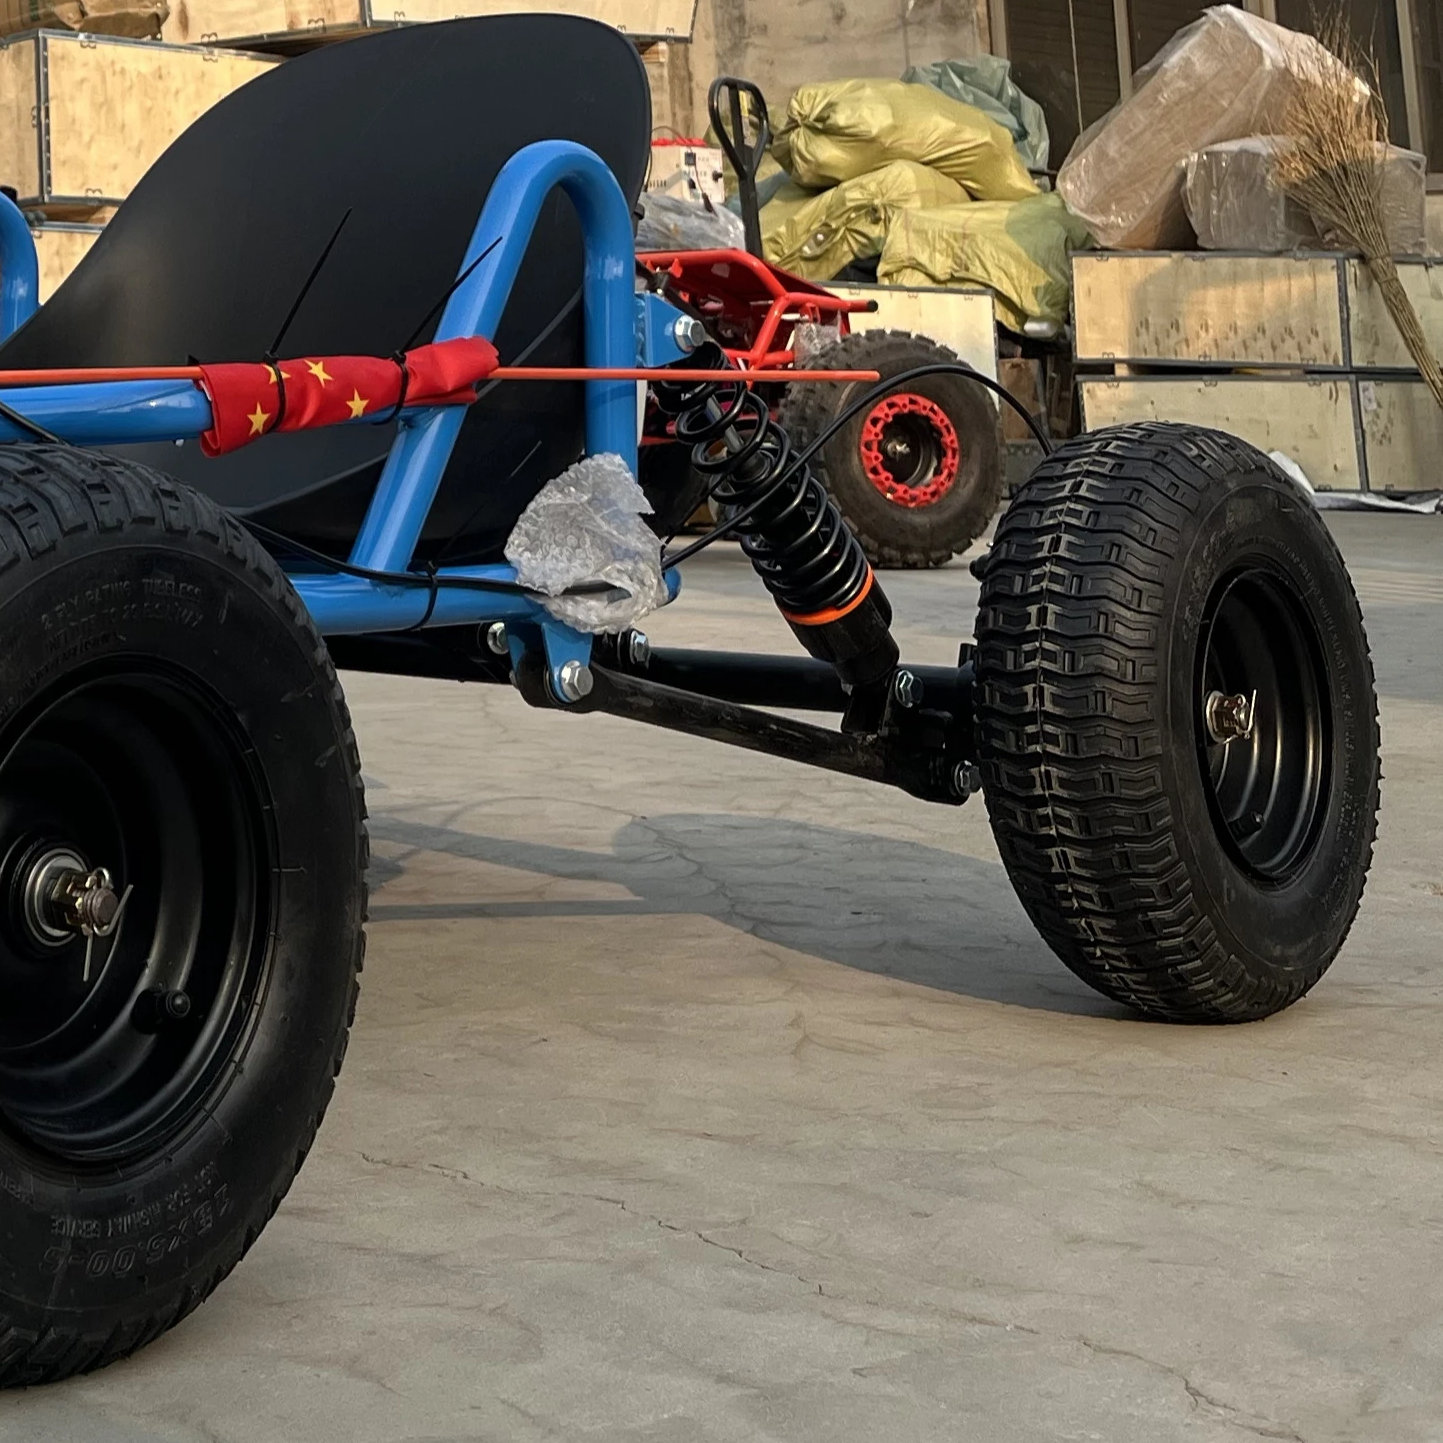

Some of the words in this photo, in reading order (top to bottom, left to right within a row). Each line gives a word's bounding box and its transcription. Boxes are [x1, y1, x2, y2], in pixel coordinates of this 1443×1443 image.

[141, 578, 203, 602] TUBELESS
[37, 1182, 234, 1279] 15X5.00-6
[50, 1214, 101, 1239] SERVICE
